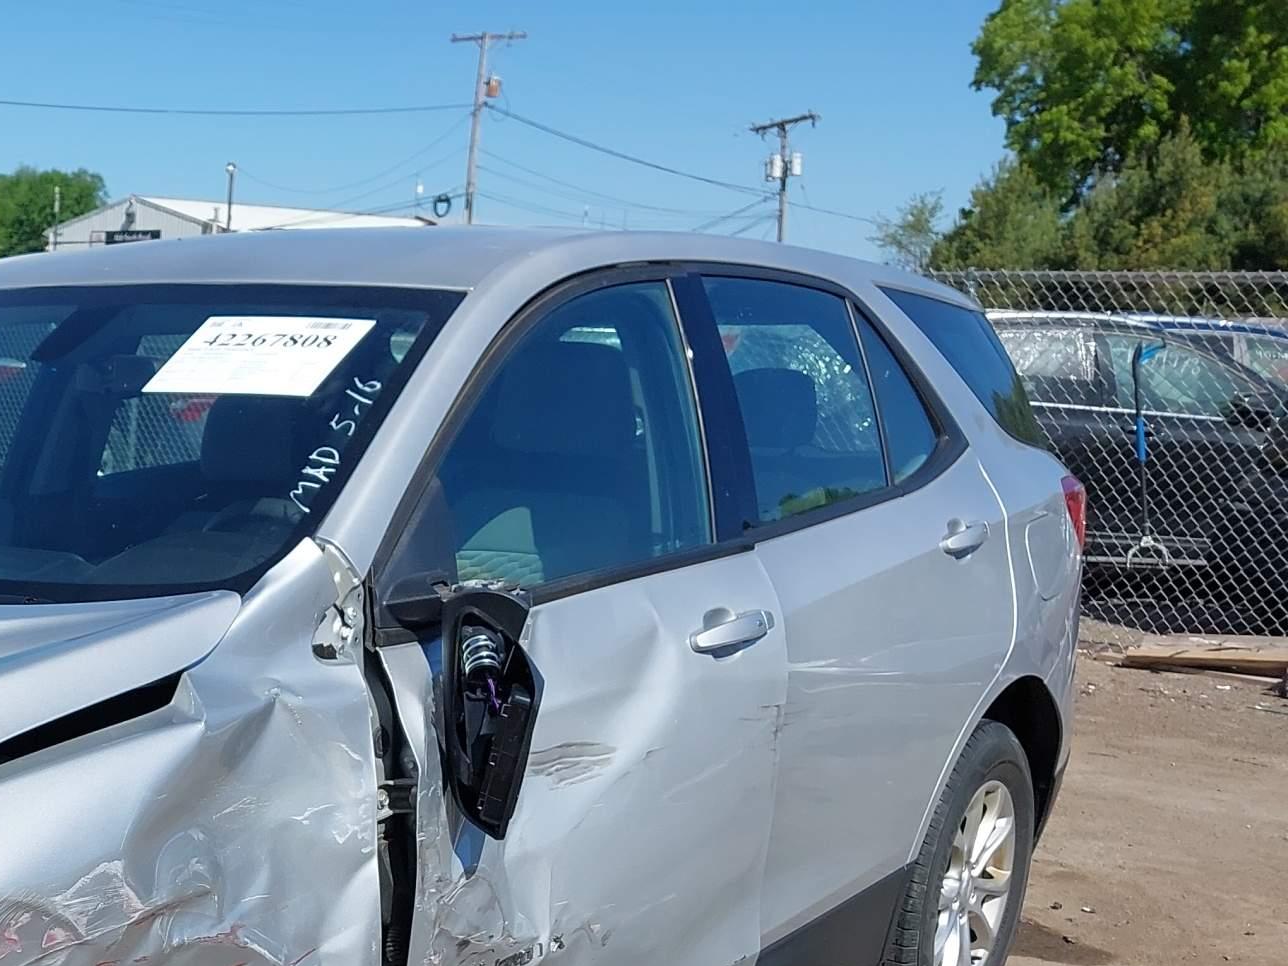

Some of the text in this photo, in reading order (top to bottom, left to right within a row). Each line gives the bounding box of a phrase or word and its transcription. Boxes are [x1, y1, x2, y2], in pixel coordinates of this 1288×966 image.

[203, 332, 338, 349] 42267808
[289, 376, 382, 513] MAD 5-16
